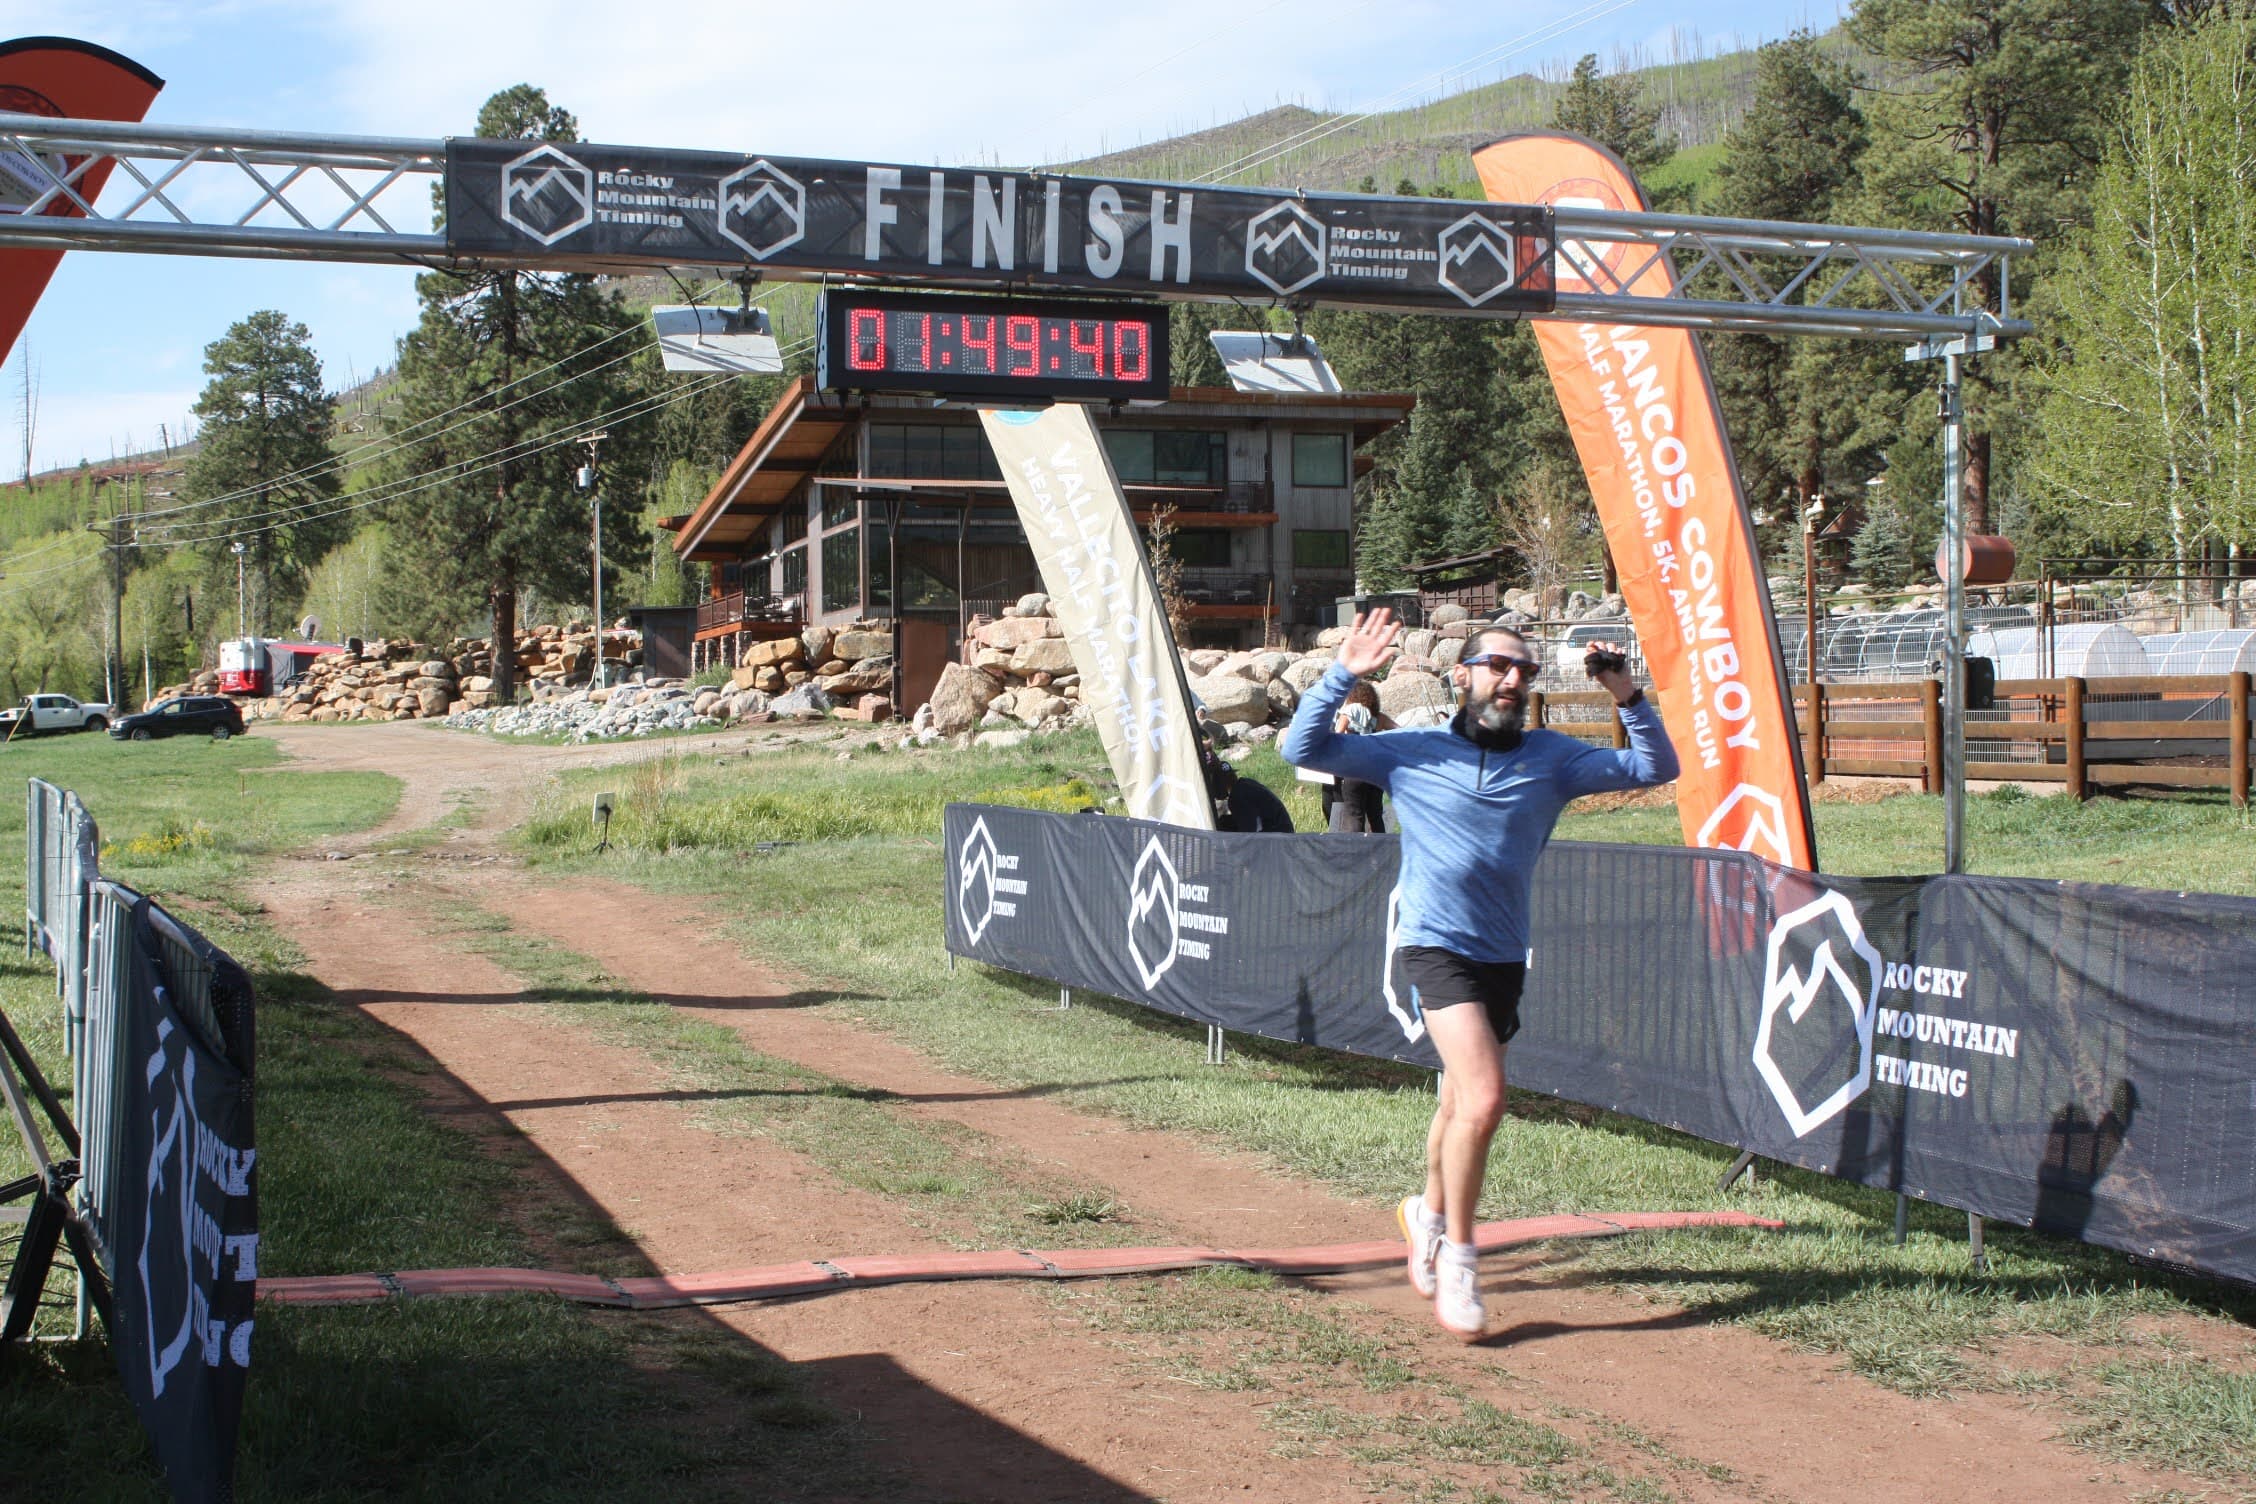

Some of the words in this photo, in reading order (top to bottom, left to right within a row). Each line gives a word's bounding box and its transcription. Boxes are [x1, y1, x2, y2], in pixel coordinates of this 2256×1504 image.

[598, 170, 674, 188] Rocky
[598, 190, 717, 210] Mountain
[599, 209, 684, 228] Timing
[864, 166, 1194, 285] FINISH
[1330, 226, 1401, 244] Rocky
[1329, 244, 1438, 262] Mountain
[1329, 262, 1409, 280] Timing
[849, 307, 1149, 382] 01:49:40
[1598, 379, 1663, 538] MARATHON,
[1020, 455, 1067, 540] HEAVY
[1056, 545, 1094, 610] HALF
[1608, 325, 1697, 508] ANCOS
[1681, 516, 1761, 751] COWBOY
[1652, 539, 1681, 583] 5K,
[1051, 440, 1141, 644] VALLECITO
[1127, 653, 1170, 753] LAKE
[1668, 588, 1697, 645] AND
[1687, 648, 1704, 707] FUN
[1693, 708, 1721, 770] RUN
[996, 854, 1020, 870] ROCKY
[995, 877, 1028, 896] MOUNTAIN
[1178, 882, 1209, 903] ROCKY
[992, 900, 1017, 918] TIMING
[1178, 910, 1228, 935] MOUNTAIN
[1177, 938, 1210, 960] TIMING
[1882, 961, 1968, 999] ROCKY
[1877, 1007, 2019, 1058] MOUNTAIN
[1874, 1053, 1968, 1098] TIMING
[199, 1119, 257, 1197] ROCKY
